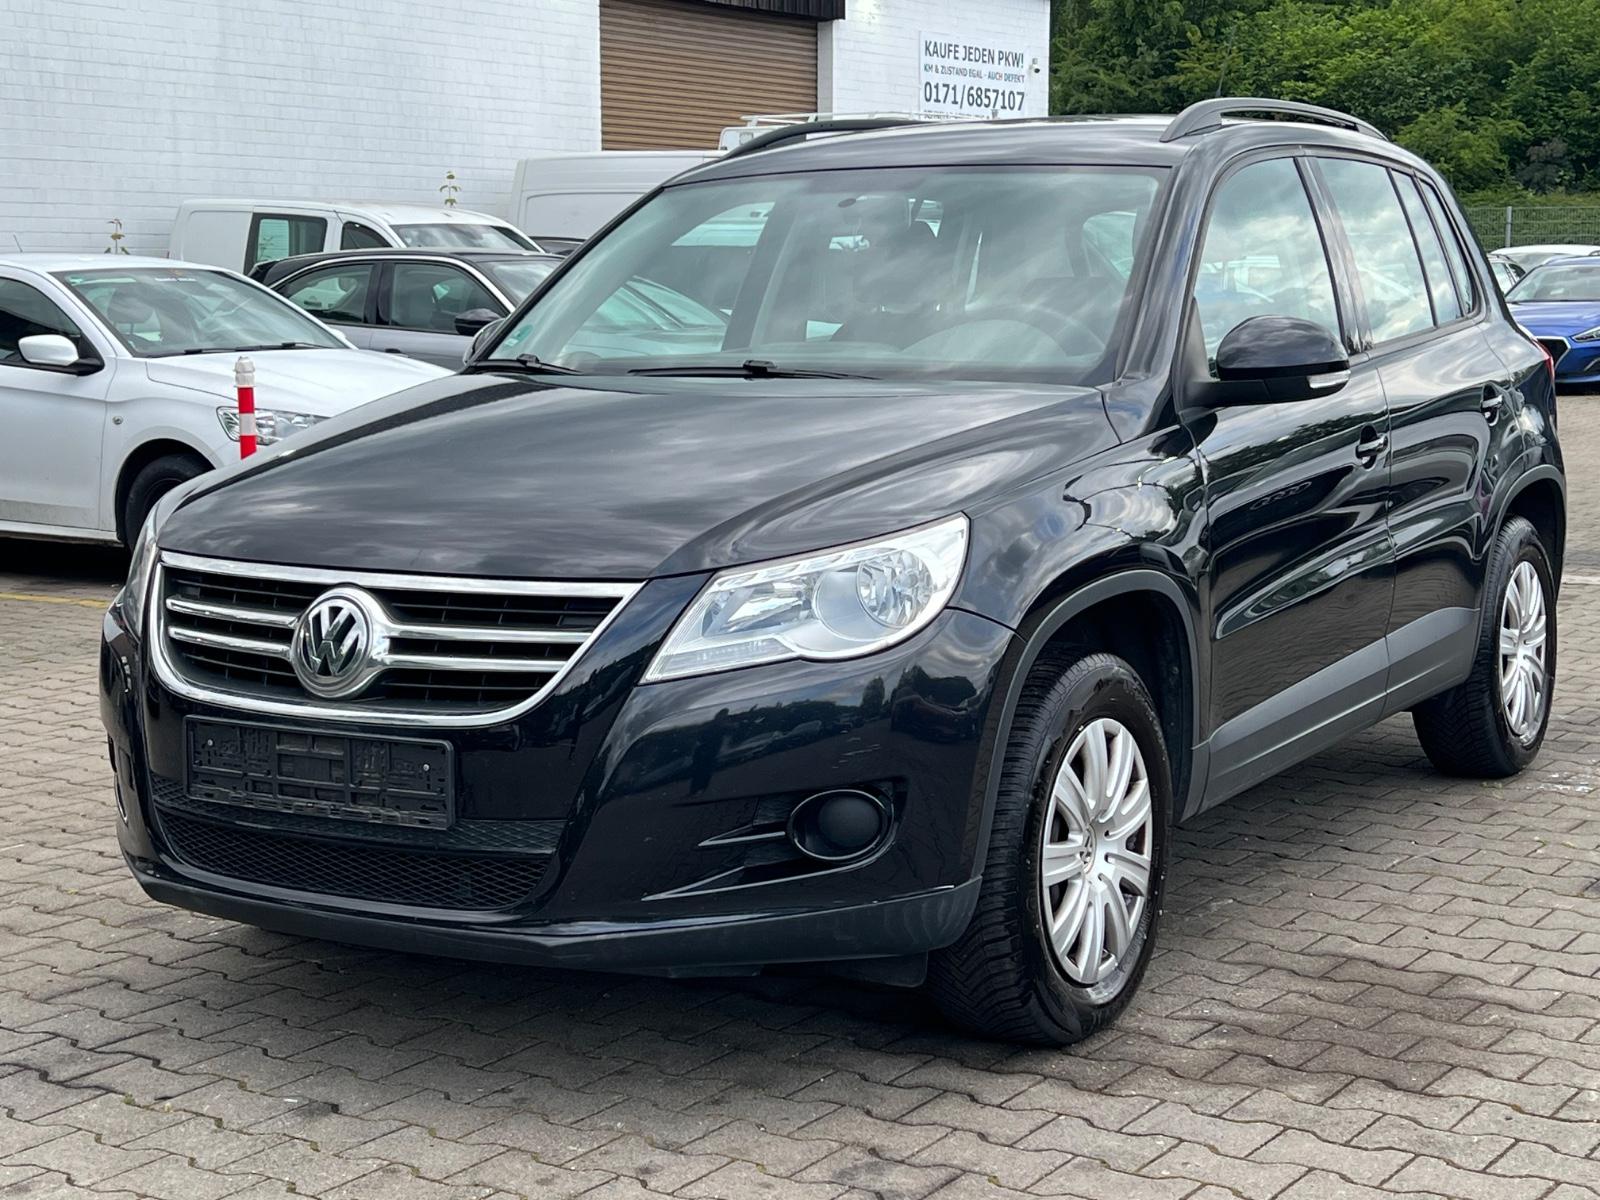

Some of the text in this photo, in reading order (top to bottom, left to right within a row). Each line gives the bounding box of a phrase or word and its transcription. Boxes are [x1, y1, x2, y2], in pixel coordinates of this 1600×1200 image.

[924, 40, 1024, 69] KAUFE JEDEN PKW!
[924, 63, 933, 73] KM
[941, 65, 968, 77] ZUSTAND
[969, 69, 983, 79] EGAL
[988, 71, 1003, 82] AUCH
[1004, 73, 1025, 83] DEFEKT
[924, 81, 1025, 111] 0171/6857107
[300, 597, 367, 686] VW
